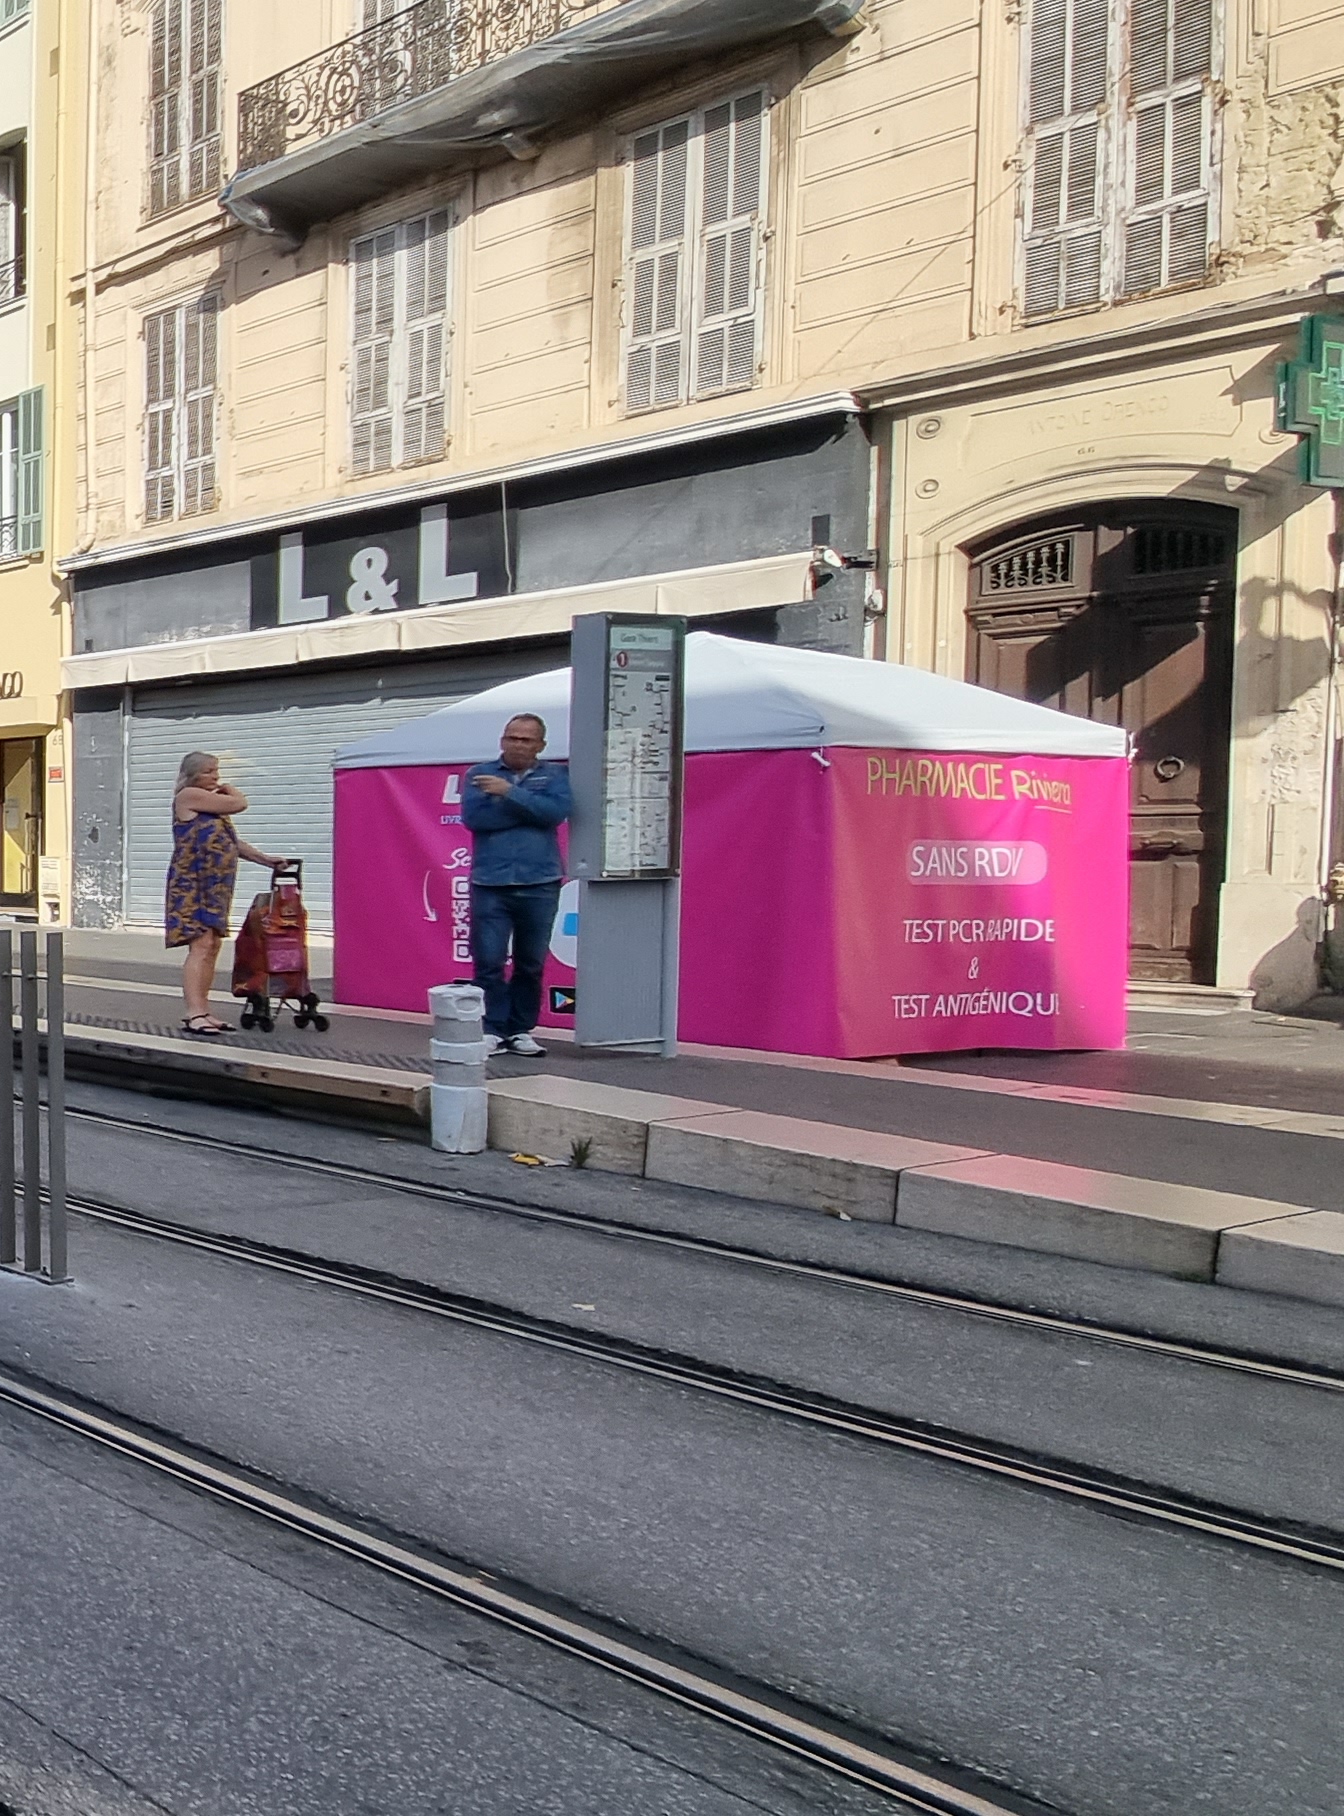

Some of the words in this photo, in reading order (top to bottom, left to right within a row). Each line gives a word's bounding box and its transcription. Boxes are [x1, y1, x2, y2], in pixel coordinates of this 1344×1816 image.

[867, 757, 1006, 800] PHARMACIE
[1011, 770, 1072, 804] Riviera
[911, 846, 968, 877] SANS
[974, 847, 1025, 877] RDV
[903, 920, 947, 943] TEST
[949, 920, 984, 943] PCR
[985, 918, 1056, 942] RAPIDE
[968, 956, 979, 980] &
[892, 994, 930, 1019] TEST
